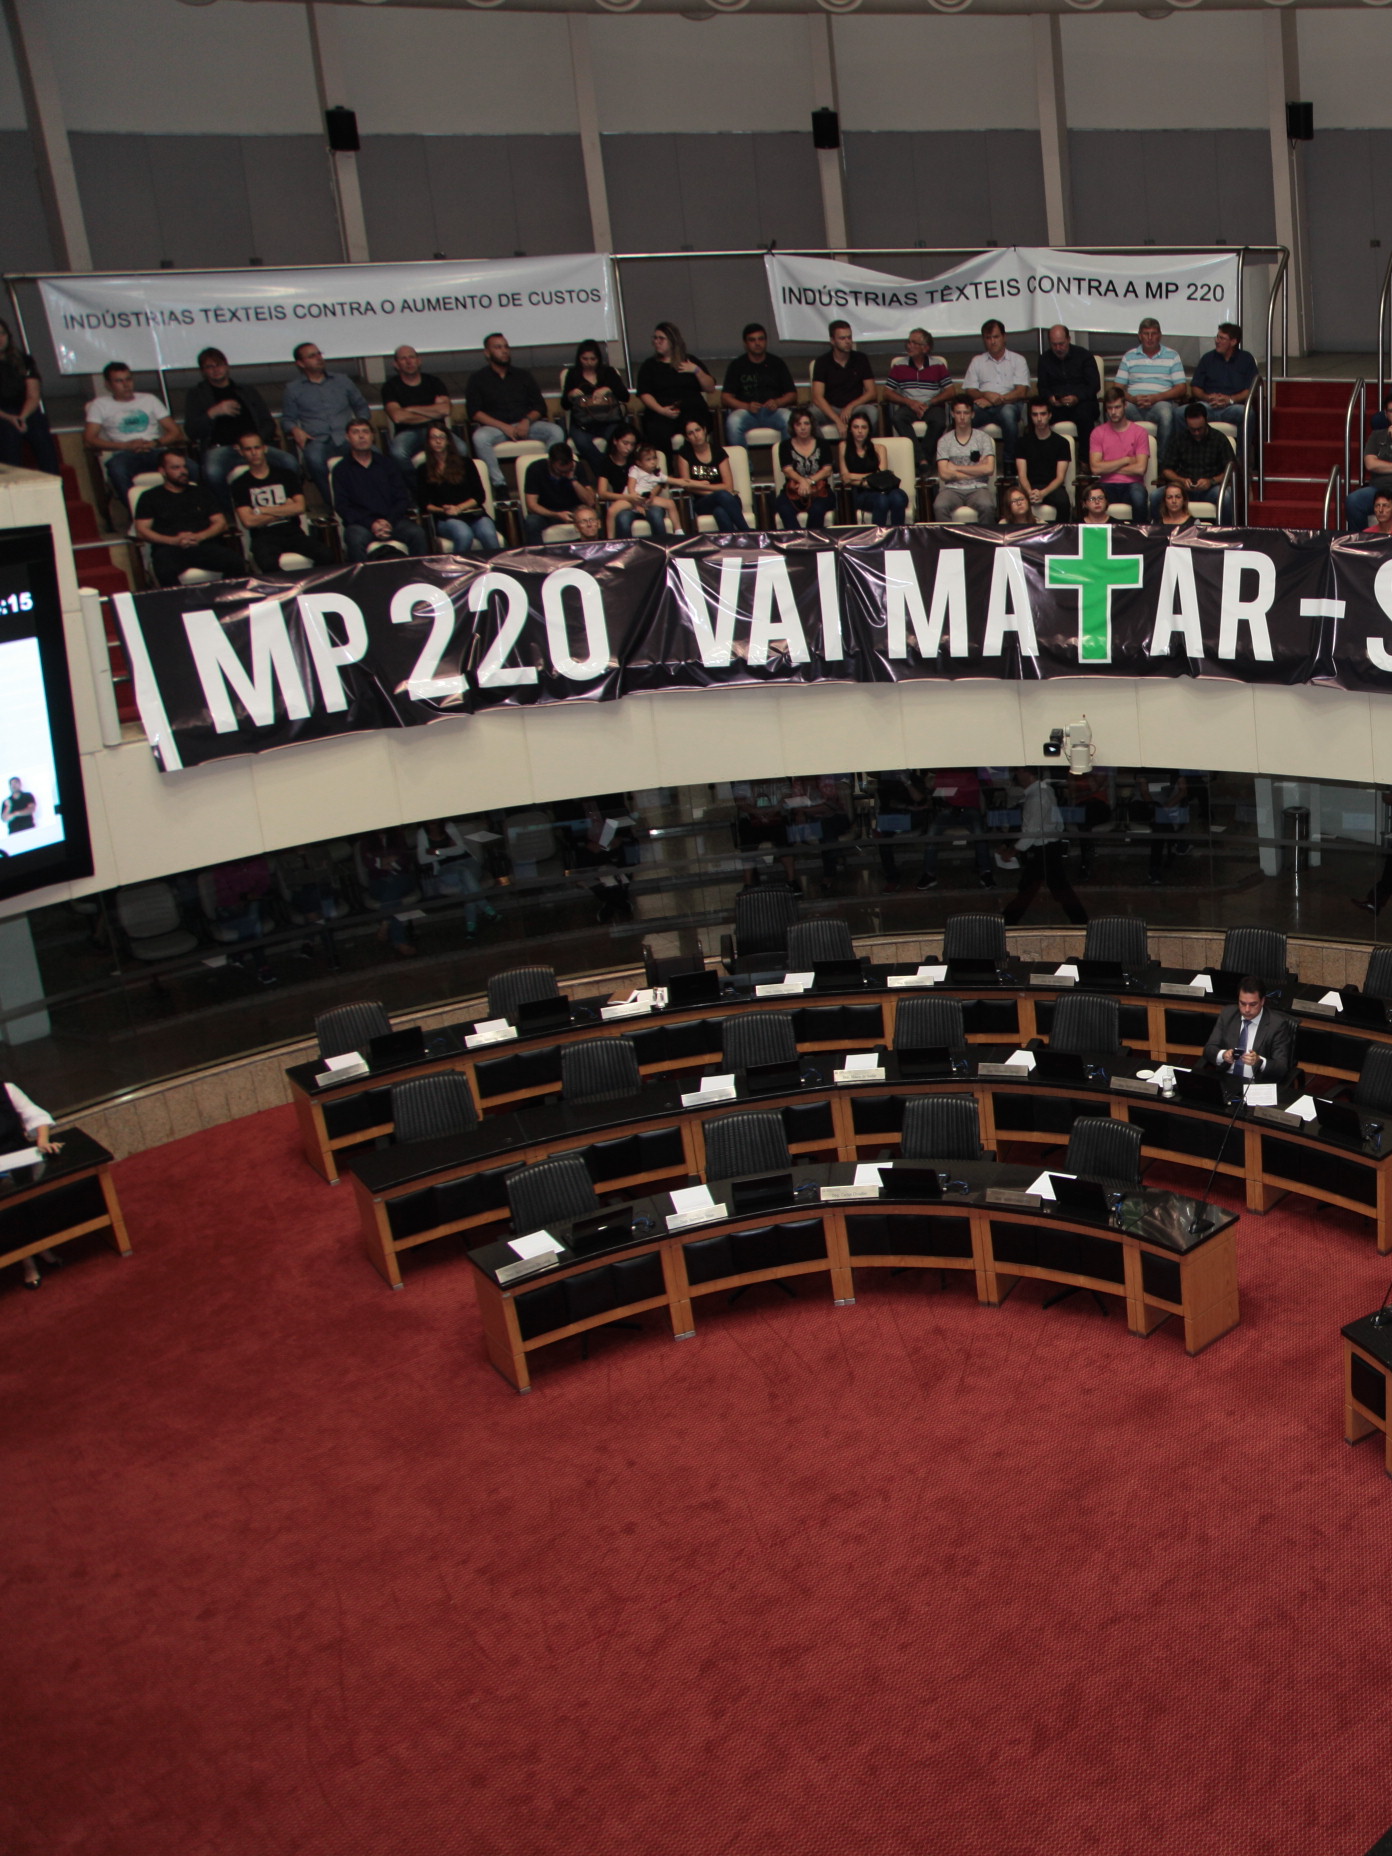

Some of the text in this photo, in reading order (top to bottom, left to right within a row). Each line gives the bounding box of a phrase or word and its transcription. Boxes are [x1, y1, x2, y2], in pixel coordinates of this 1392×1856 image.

[63, 287, 602, 331] INDÚSTRIAS TÊXTEIS CONTRA O AUMENTO DE CUSTOS
[781, 275, 1226, 307] INDÚSTRIAS TÊXTEIS CONTRA A MP 220
[182, 591, 370, 734] MP
[389, 567, 611, 702] 220
[676, 551, 845, 668] VAI
